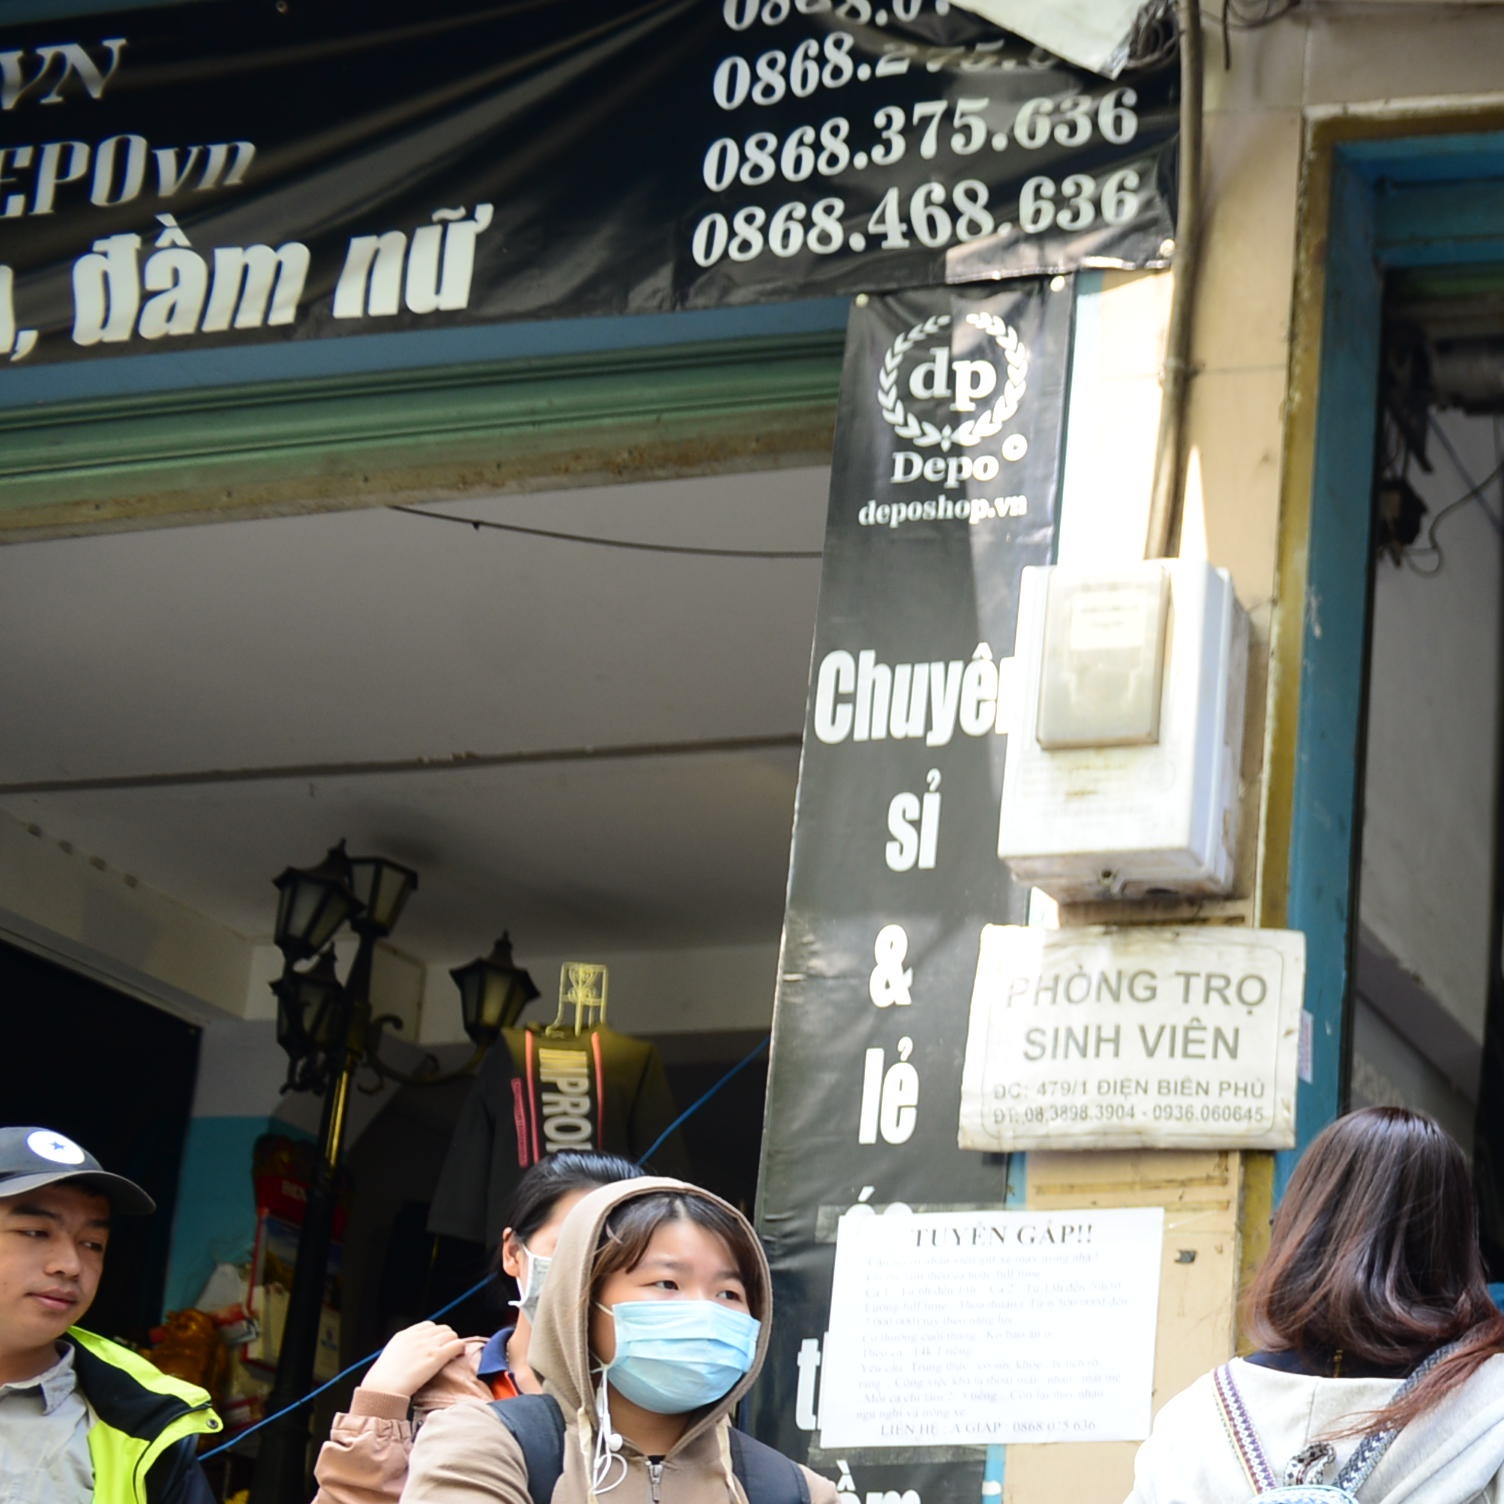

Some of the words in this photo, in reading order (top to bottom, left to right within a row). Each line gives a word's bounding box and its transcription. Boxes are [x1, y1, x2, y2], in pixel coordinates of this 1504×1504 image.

[703, 88, 1138, 192] 0868.375.636
[692, 170, 1142, 267] 0868.468.636
[71, 213, 311, 346] đầm
[332, 203, 494, 320] nữ
[908, 346, 997, 412] dp
[890, 452, 1000, 489] Depo
[858, 494, 1028, 528] deposhop.vn
[885, 769, 942, 872] sỉ
[868, 924, 913, 1008] &
[1007, 964, 1158, 1007] PHÒNG
[1174, 970, 1268, 1015] TRỌ
[1022, 1023, 1121, 1062] SINH
[1138, 1016, 1241, 1060] VIÊN
[858, 1036, 920, 1145] lẻ
[1036, 1079, 1089, 1096] 479/1
[1157, 1075, 1210, 1097] BIÊN
